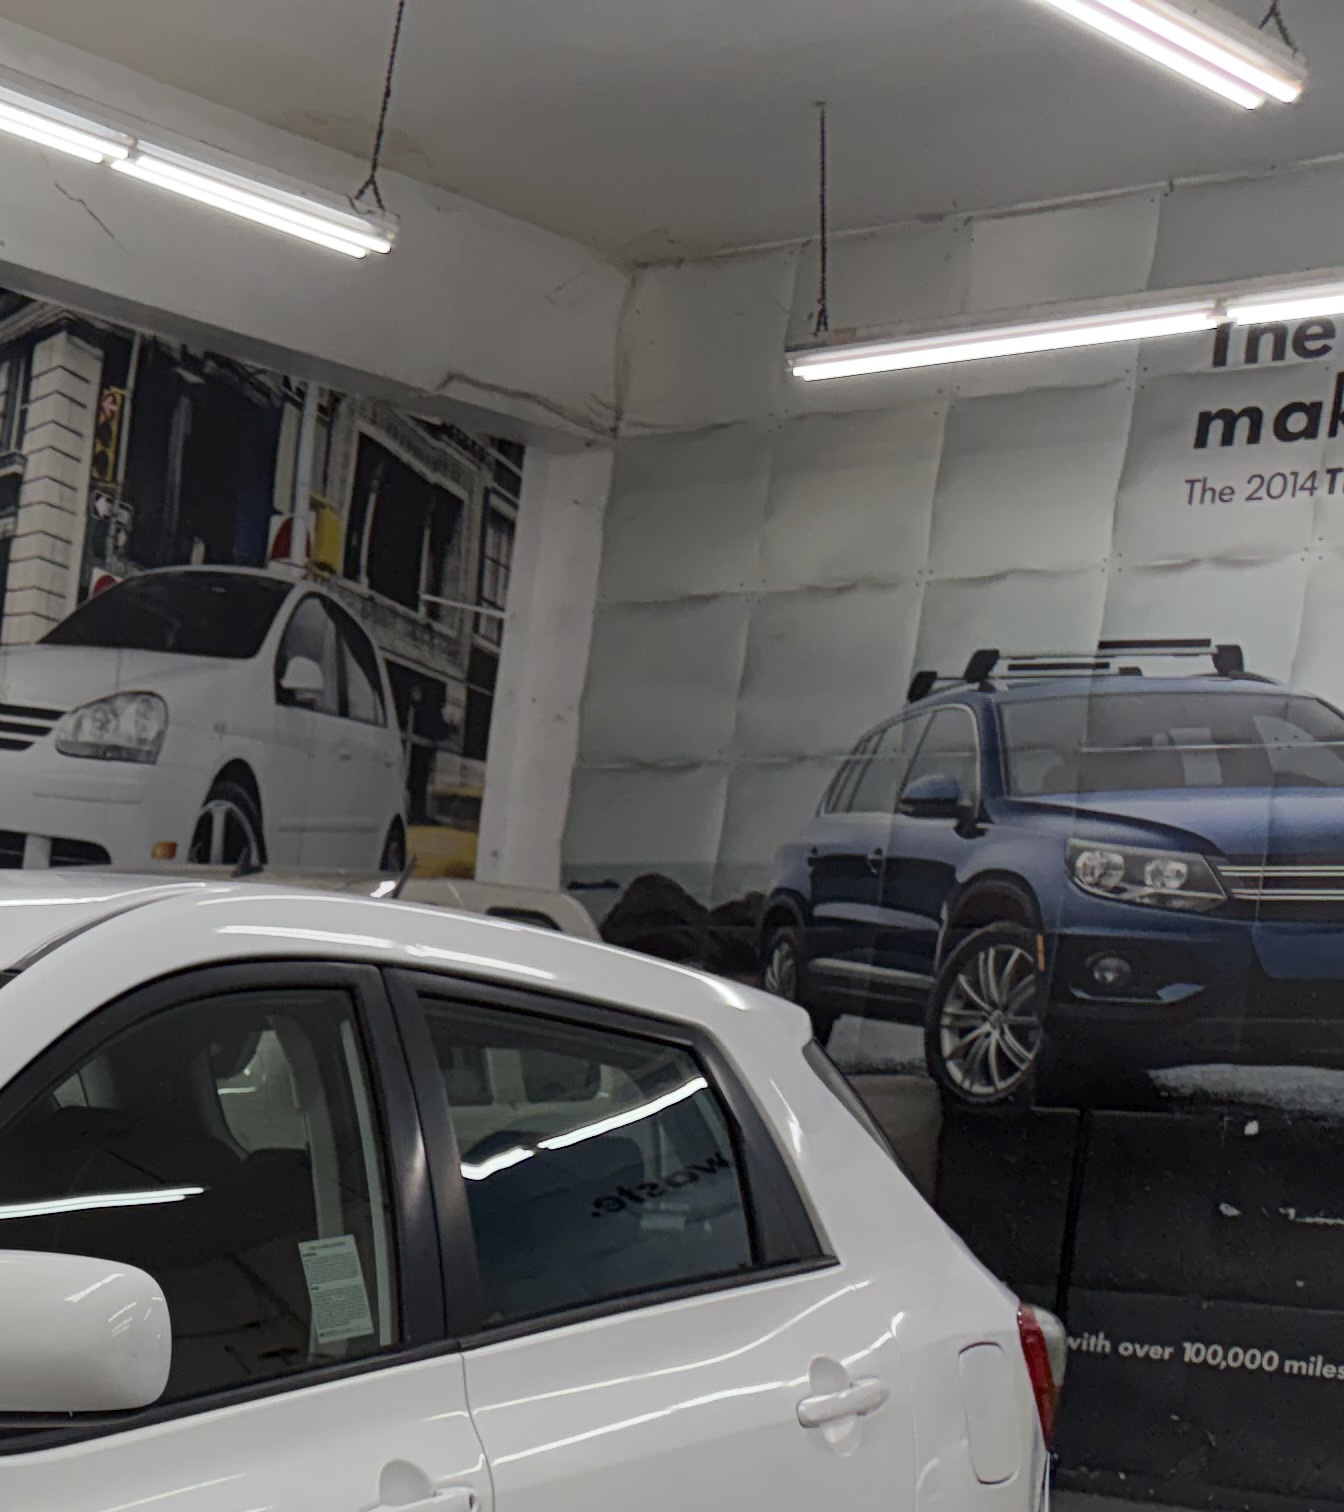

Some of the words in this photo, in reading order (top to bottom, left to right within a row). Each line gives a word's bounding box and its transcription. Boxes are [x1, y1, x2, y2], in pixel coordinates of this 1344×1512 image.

[1185, 477, 1236, 505] The
[1245, 469, 1319, 502] 2014
[1118, 1341, 1175, 1361] over
[1182, 1341, 1280, 1371] 100,000
